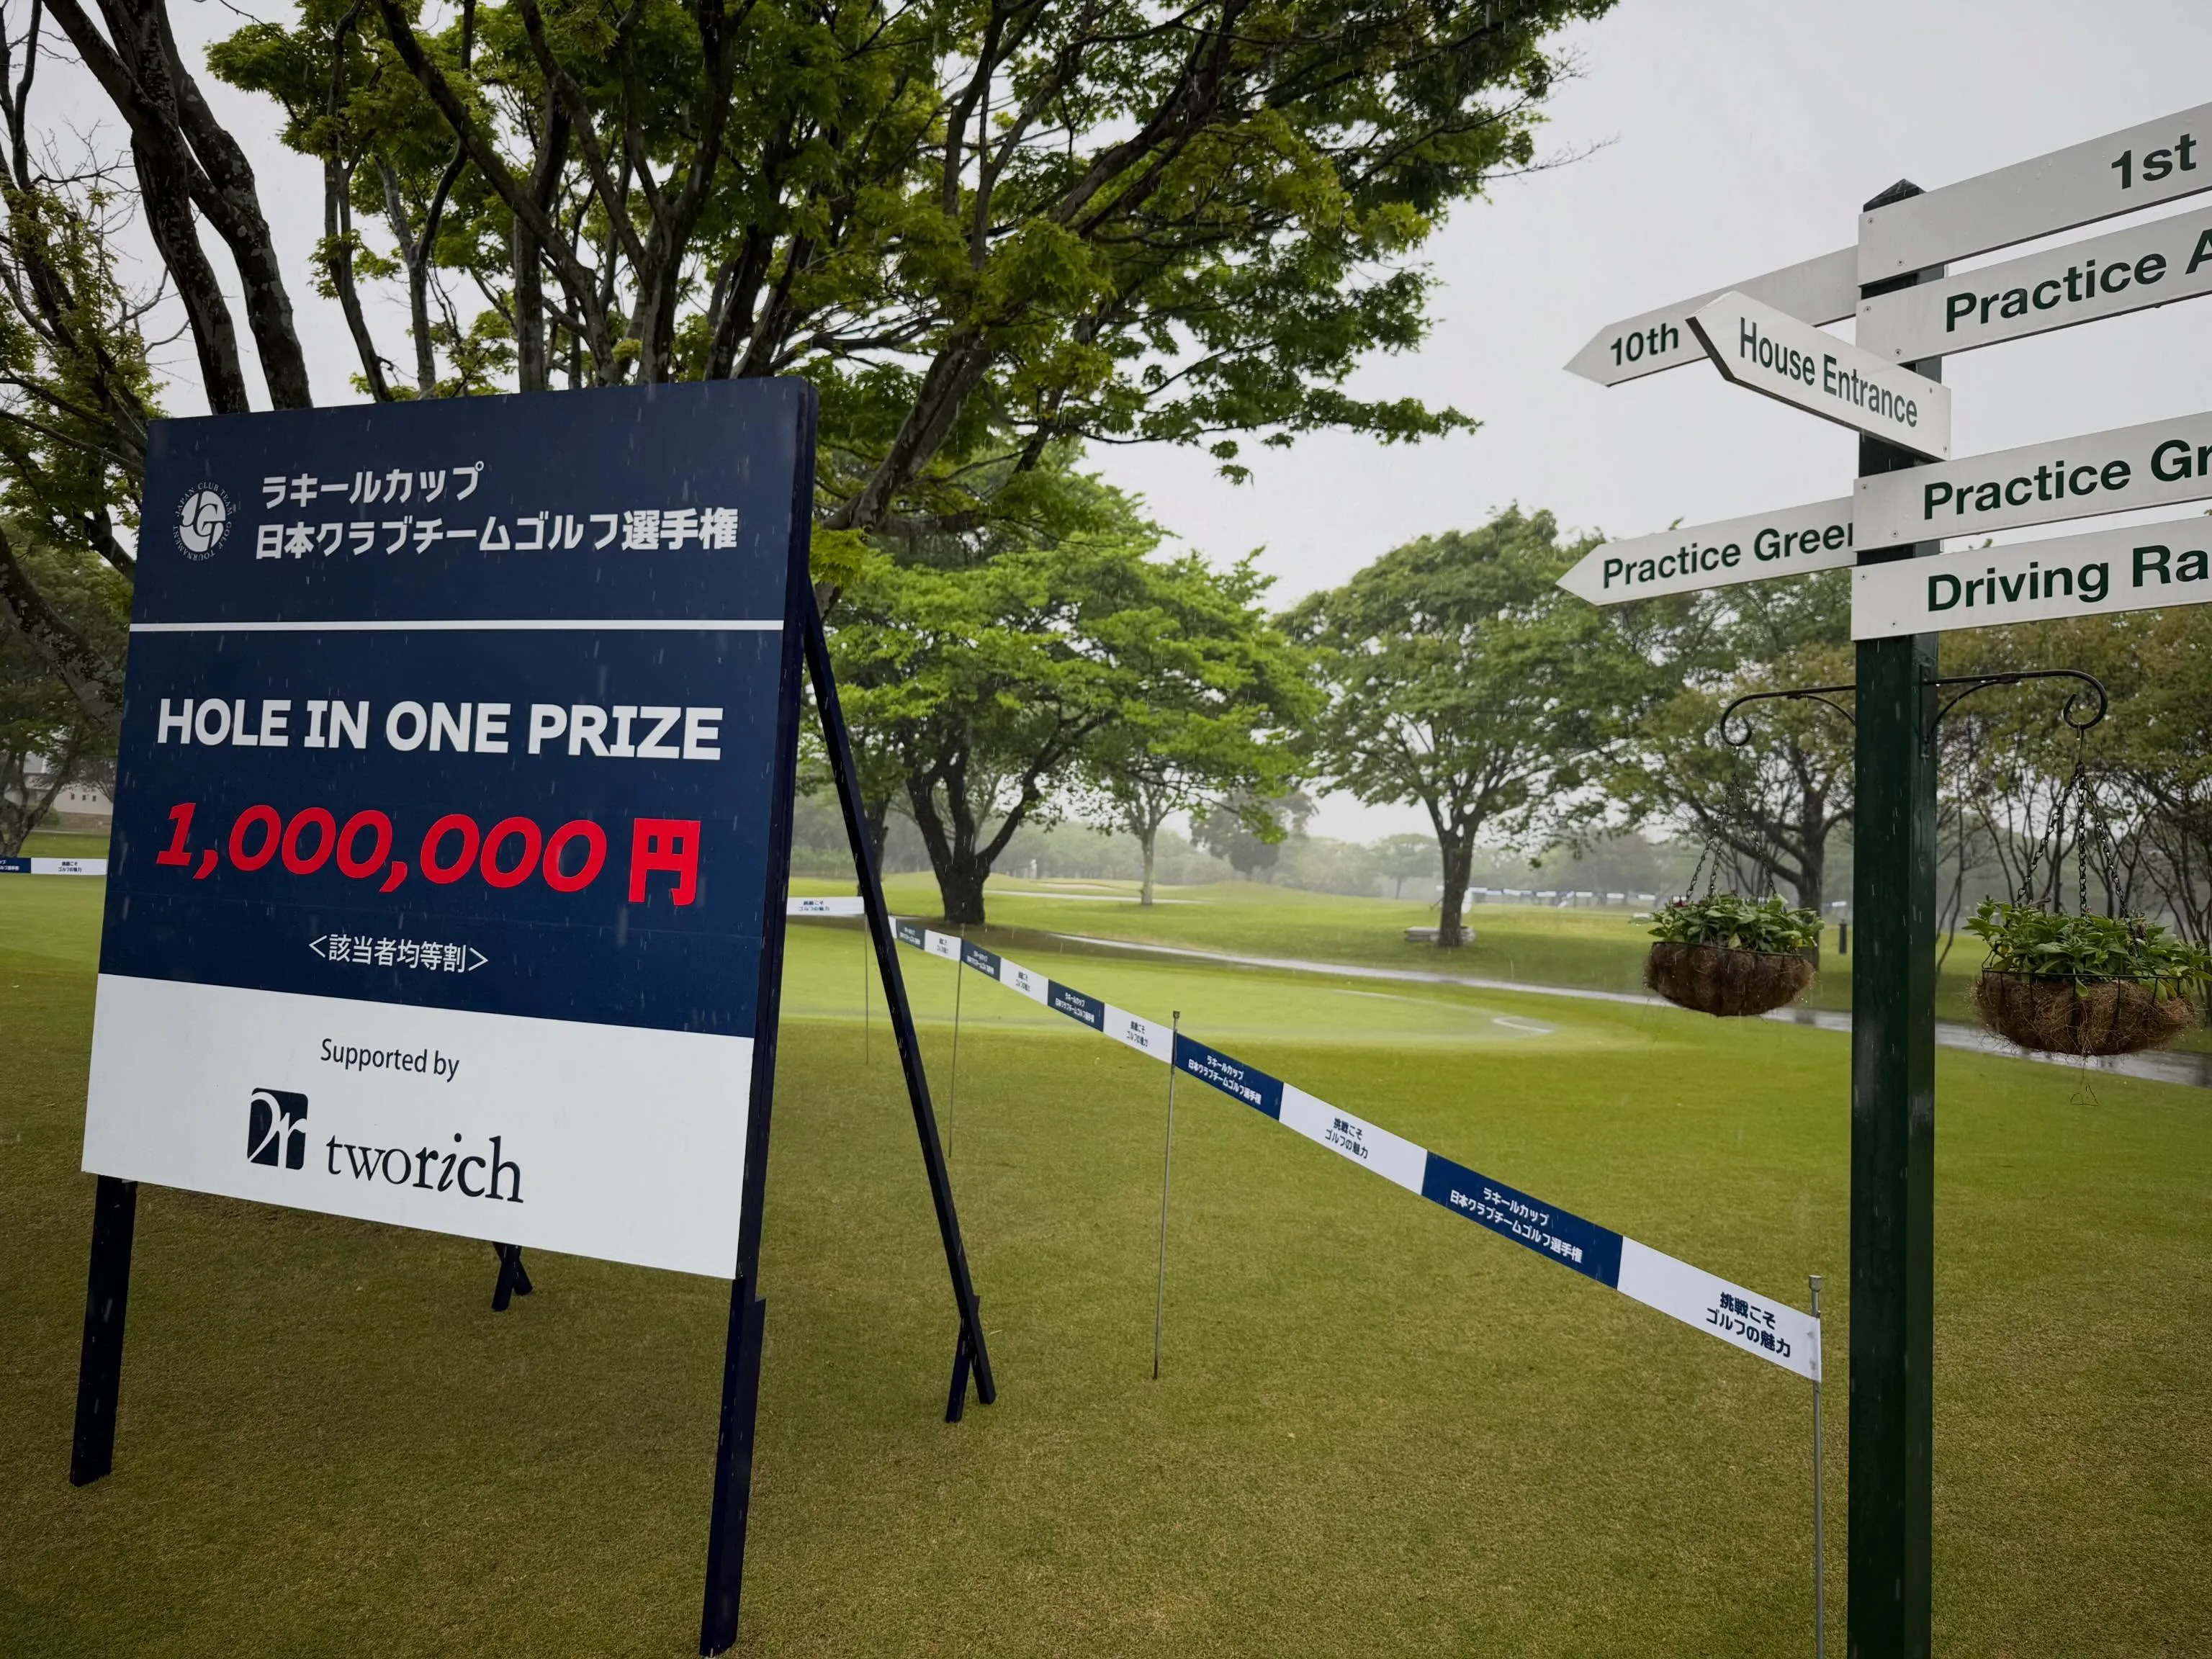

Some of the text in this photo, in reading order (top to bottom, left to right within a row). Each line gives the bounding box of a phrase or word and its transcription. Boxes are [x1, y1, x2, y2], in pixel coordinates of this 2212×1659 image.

[2111, 133, 2198, 190] 1st
[1946, 253, 2167, 333] Practice
[1609, 323, 1680, 367] 10th
[1739, 317, 1918, 429] House Entrance
[197, 481, 220, 492] CLUB
[220, 489, 233, 516] TEAM
[262, 460, 485, 508] ラキールカップ
[1923, 457, 2131, 521] Practice
[256, 506, 739, 559] 日本クラブチームゴルフ選手権
[1603, 540, 1741, 590] Practice
[1928, 544, 2209, 613] Driving Ra
[157, 698, 724, 760] HOLE IN ONE PRIZE
[156, 802, 701, 906] 1,000,000 円
[320, 1038, 460, 1083] Supported by
[325, 1133, 524, 1203] tworich
[1449, 1190, 1583, 1263] 日本クラブチームゴルフ選手権
[1483, 1187, 1550, 1226] ラキールカップ
[1706, 1307, 1791, 1359] ゴルフの魅力
[1719, 1291, 1776, 1330] 挑戦こそ
